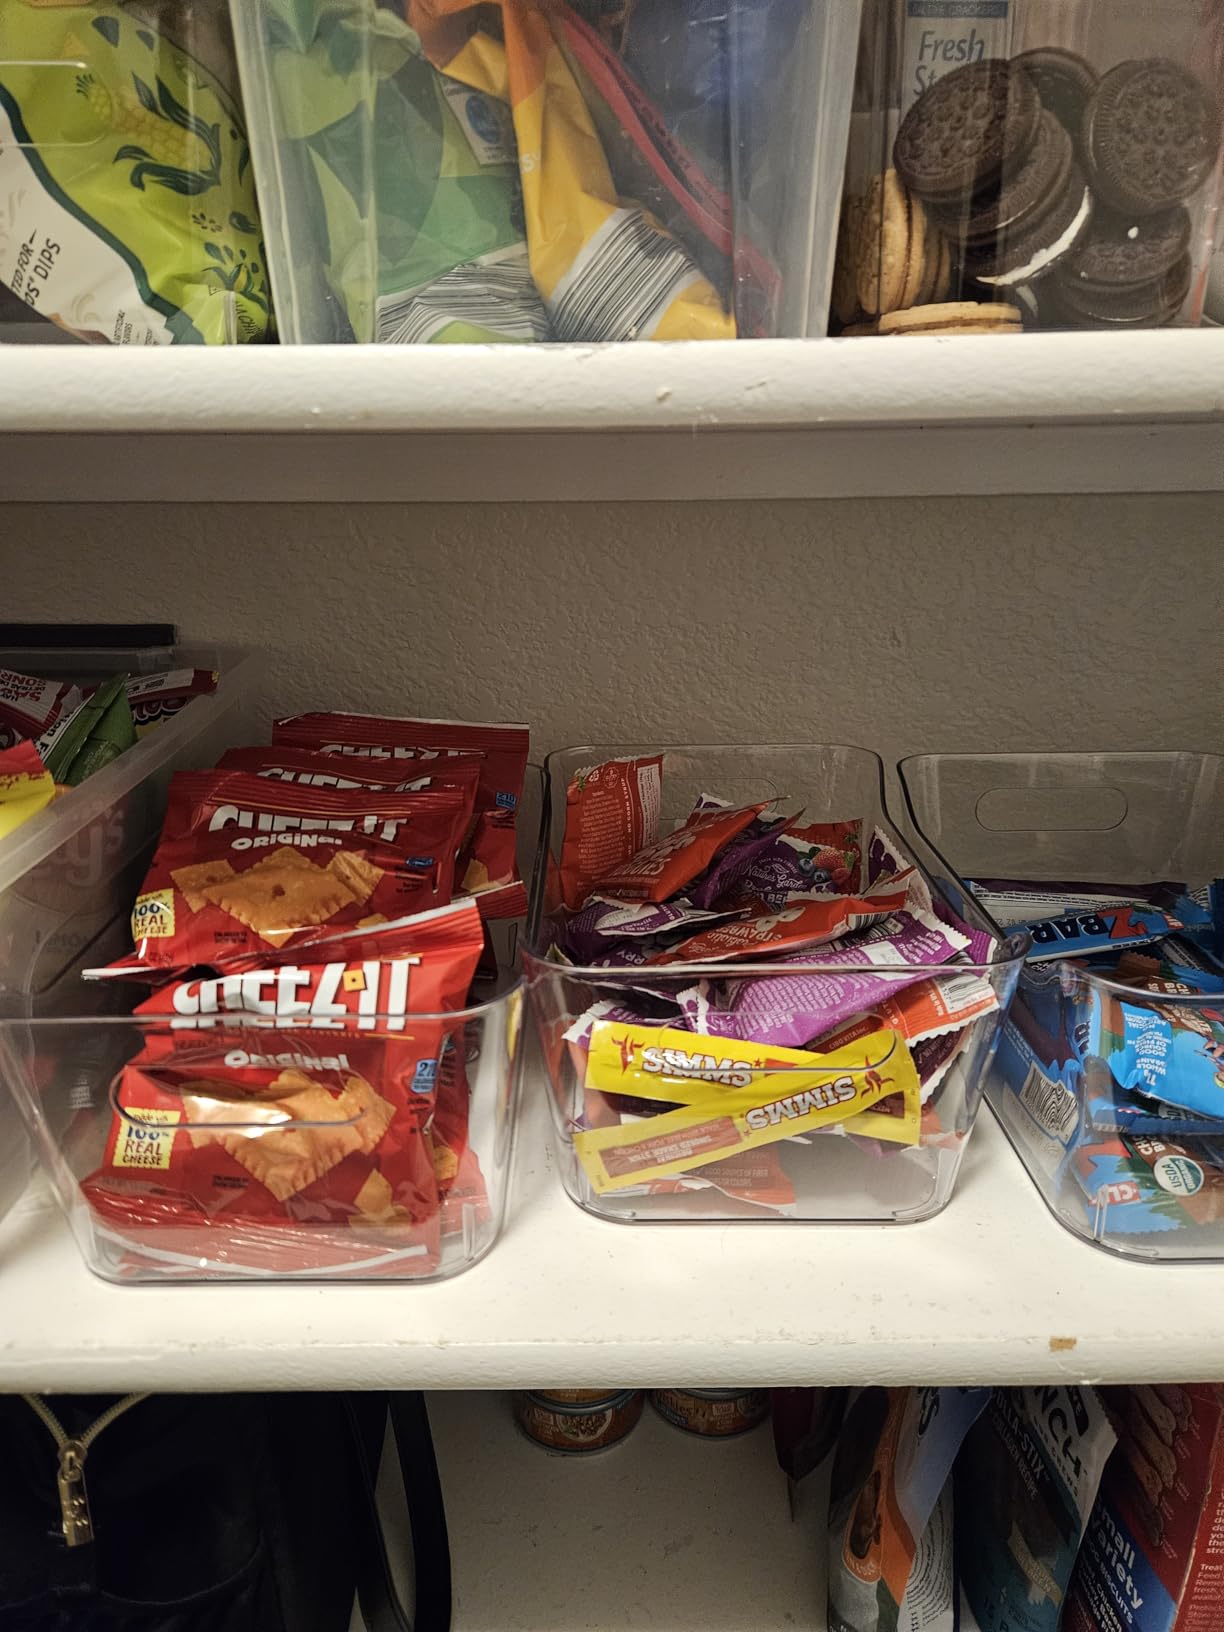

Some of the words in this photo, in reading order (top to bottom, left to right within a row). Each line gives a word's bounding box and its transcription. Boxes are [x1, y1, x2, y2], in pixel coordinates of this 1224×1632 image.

[919, 29, 985, 61] Fresh
[17, 243, 33, 273] FOR
[34, 238, 61, 280] DIPS
[1026, 914, 1109, 943] BAR
[746, 1076, 857, 1130] SIMMS
[122, 1155, 163, 1167] CHEESE
[124, 1140, 163, 1156] REAL
[1161, 1163, 1182, 1188] USDA
[1101, 1505, 1135, 1569] mall
[1200, 1563, 1223, 1572] Treat
